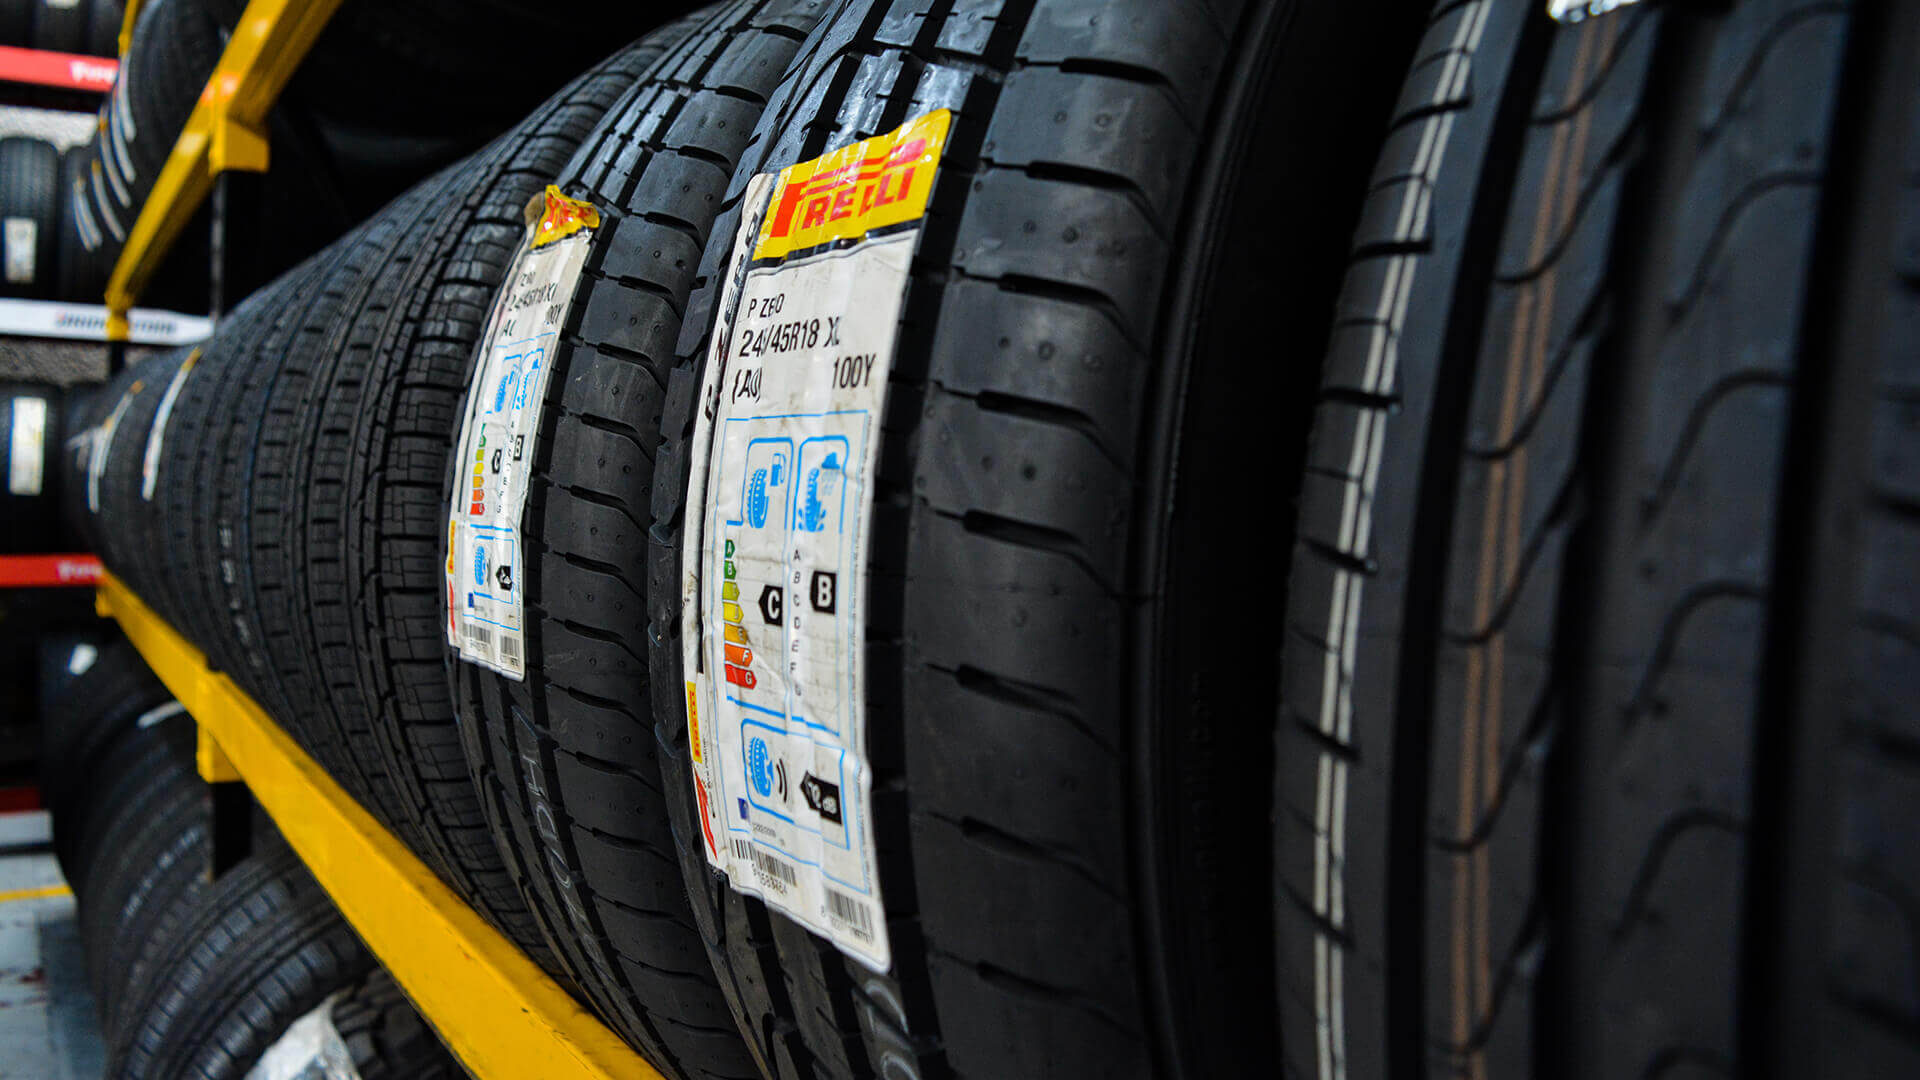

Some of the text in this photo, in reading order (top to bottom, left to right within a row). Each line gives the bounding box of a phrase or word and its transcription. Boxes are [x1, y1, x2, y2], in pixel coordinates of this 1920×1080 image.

[748, 298, 757, 319] P
[831, 352, 877, 390] 100Y
[792, 549, 802, 561] A
[793, 571, 801, 584] B
[817, 575, 832, 608] B
[769, 590, 781, 620] C
